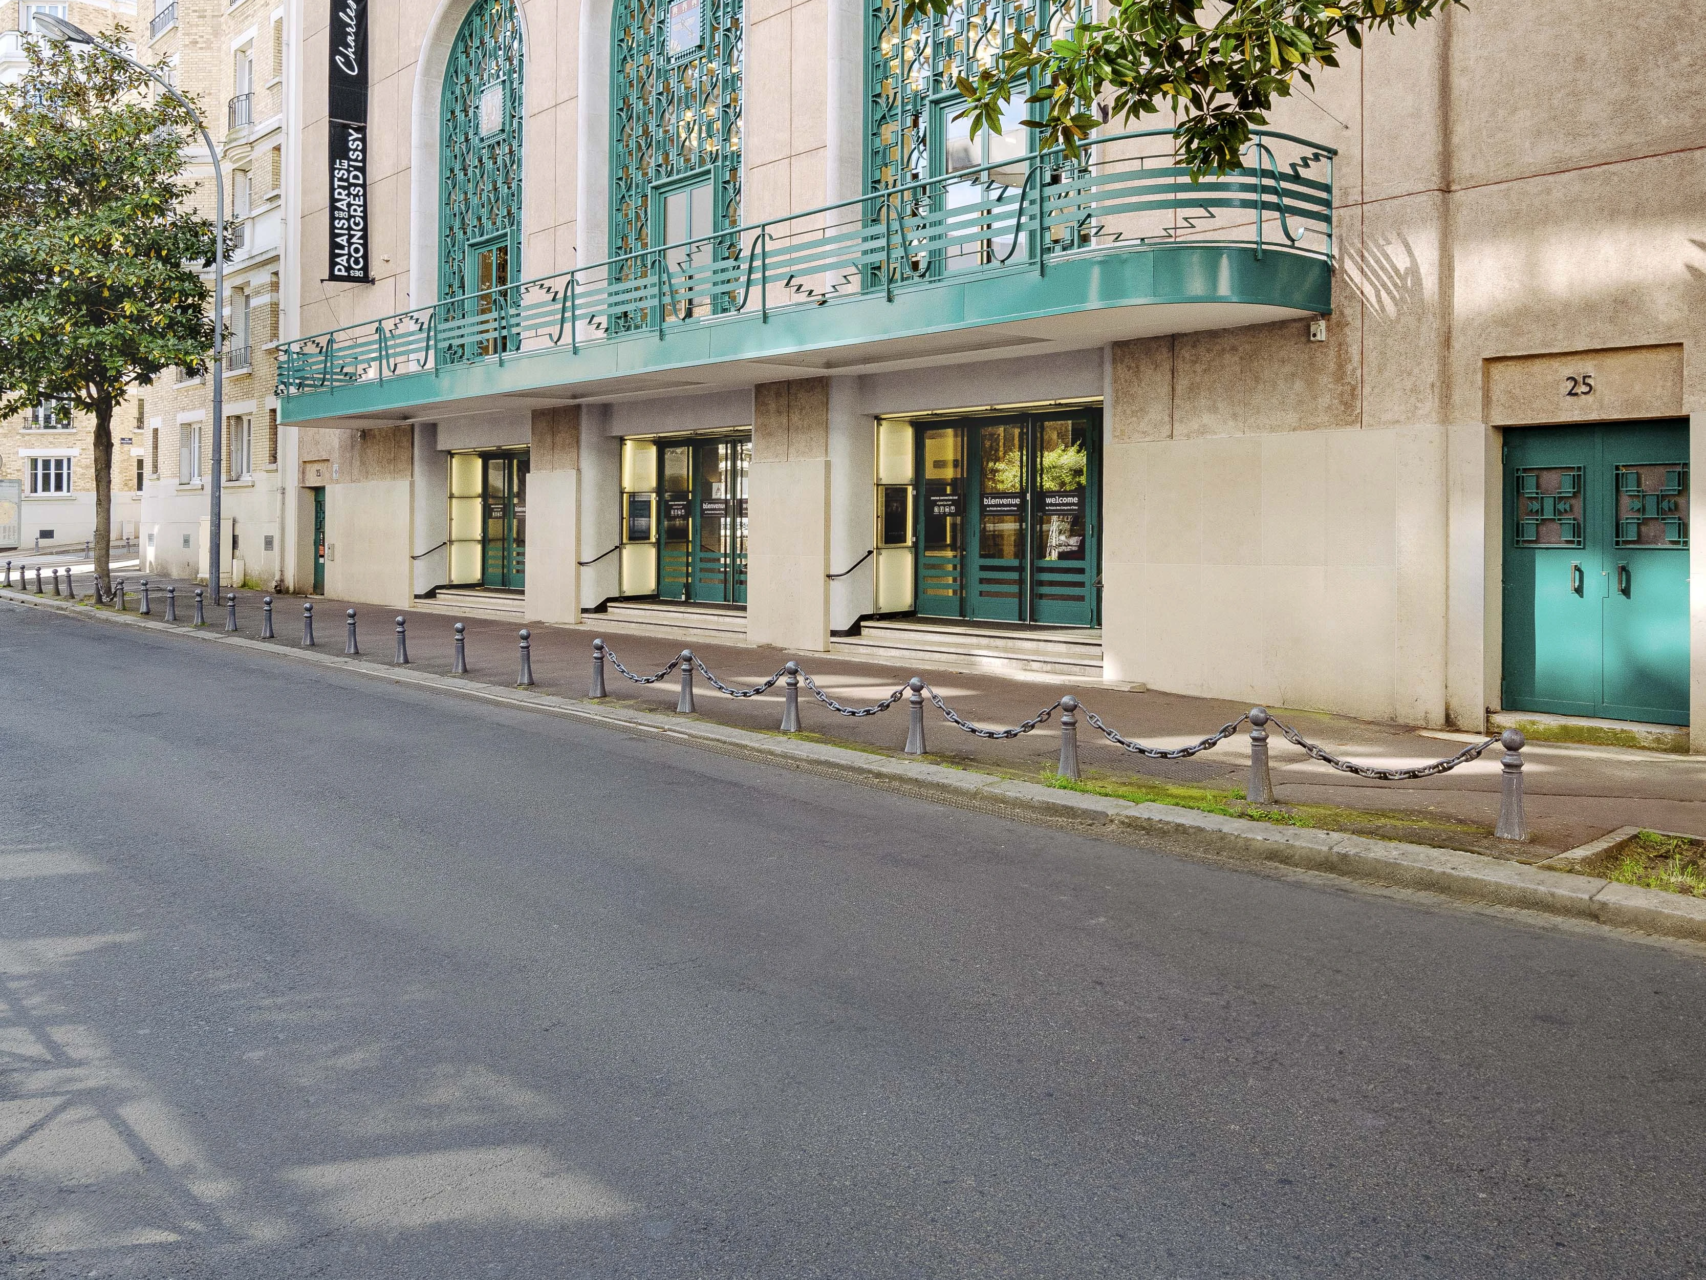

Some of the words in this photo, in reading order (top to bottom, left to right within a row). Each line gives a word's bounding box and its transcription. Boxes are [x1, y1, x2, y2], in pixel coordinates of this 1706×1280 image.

[333, 159, 348, 169] ET
[348, 129, 363, 184] D'ISSY
[334, 169, 350, 211] ARTS
[334, 210, 349, 218] DES
[348, 186, 364, 269] CONGRÈS
[334, 219, 349, 276] PALAIS
[1566, 375, 1593, 396] 25
[983, 497, 1021, 505] bienvenue
[1045, 496, 1079, 504] welcome
